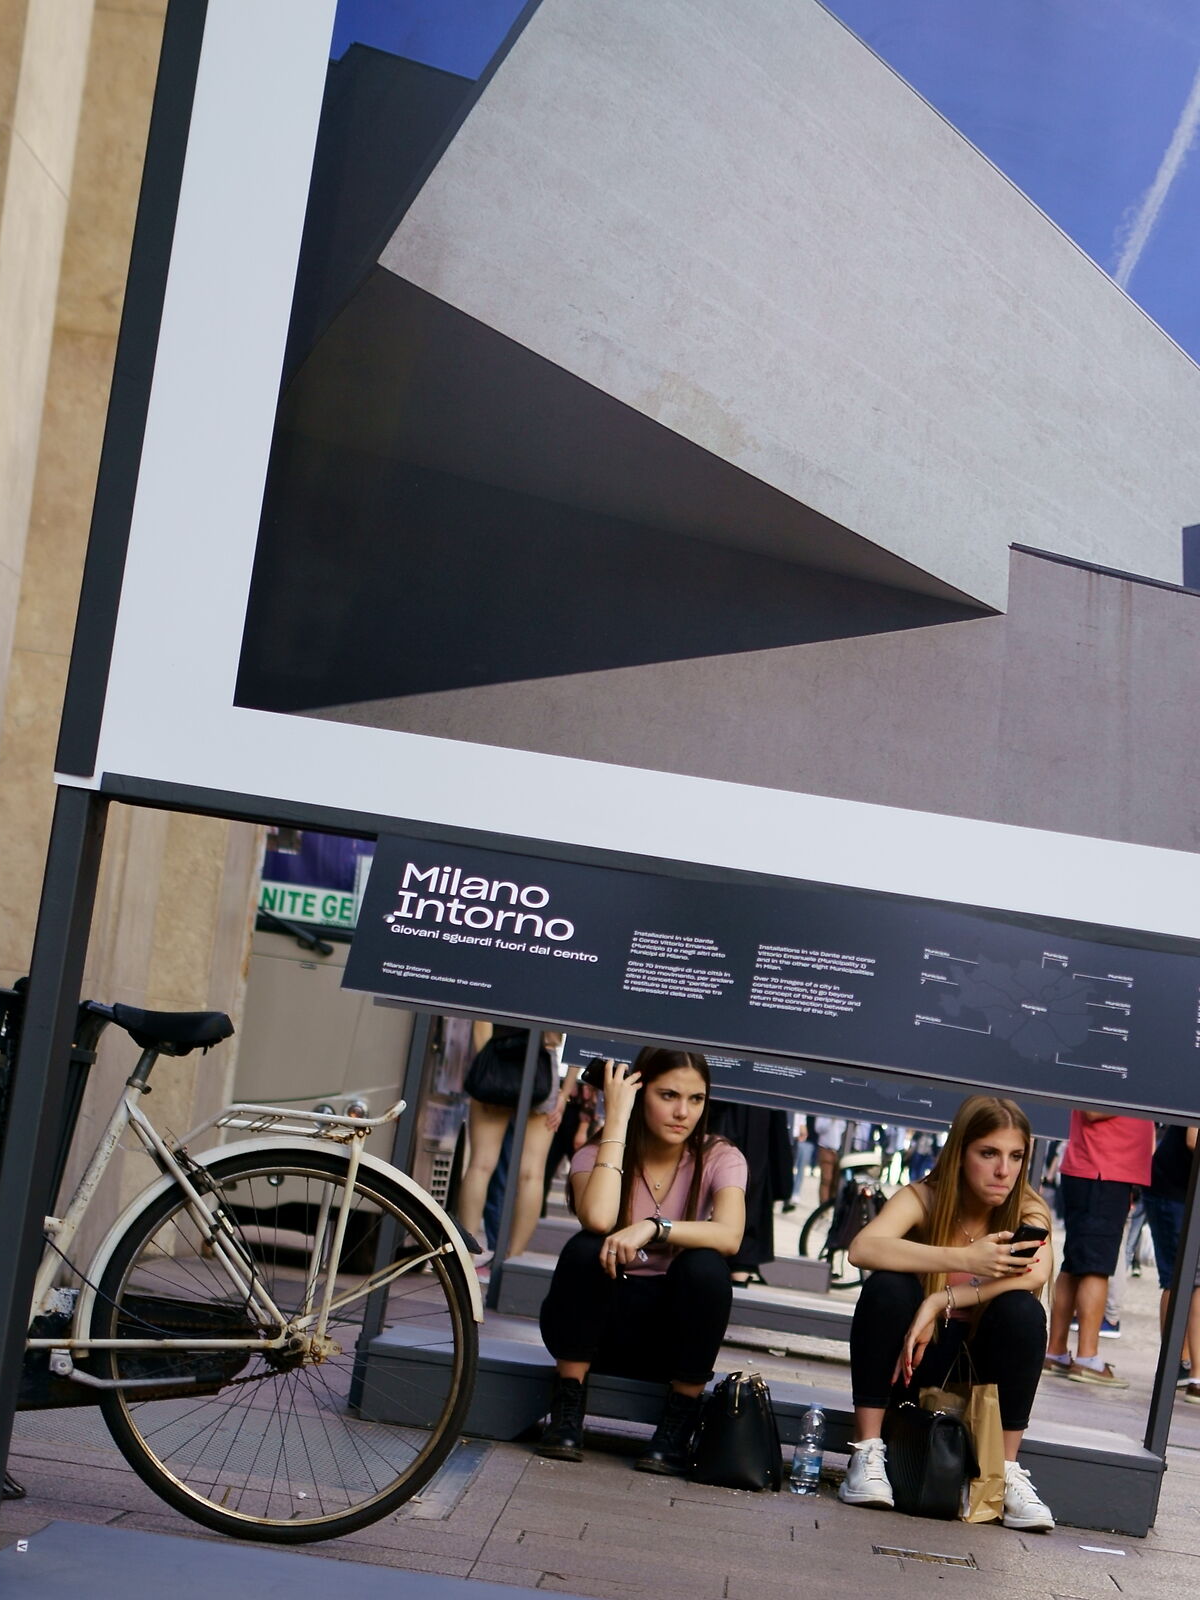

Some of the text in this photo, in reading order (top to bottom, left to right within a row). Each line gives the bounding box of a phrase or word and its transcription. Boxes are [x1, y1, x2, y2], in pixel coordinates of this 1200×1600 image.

[401, 862, 550, 909] Milano
[393, 890, 575, 941] Intorno
[634, 930, 674, 940] Installazioni
[390, 924, 598, 963] Giovani sguardi fuori dal centro
[631, 943, 665, 952] (Municipio
[685, 942, 718, 951] Emanuele
[759, 944, 800, 954] Installations
[630, 949, 657, 957] Municipi
[783, 953, 816, 962] Emanuele
[818, 958, 859, 968] (Municipality
[383, 962, 431, 973] Milano Intorno
[627, 967, 656, 975] continuo
[654, 964, 684, 972] immagini
[811, 963, 828, 971] eight
[829, 965, 874, 977] Municipalities
[382, 968, 402, 976] Young
[403, 971, 429, 980] glances
[430, 975, 455, 983] outside
[647, 976, 677, 984] concetto
[630, 980, 660, 988] restituire
[669, 985, 711, 994] connessione
[631, 987, 669, 995] espressioni
[752, 982, 782, 990] constant
[828, 991, 854, 999] beyond
[764, 990, 792, 998] concept
[814, 996, 846, 1006] periphery
[762, 1002, 802, 1012] expressions
[785, 999, 823, 1008] connection
[824, 1003, 853, 1012] between
